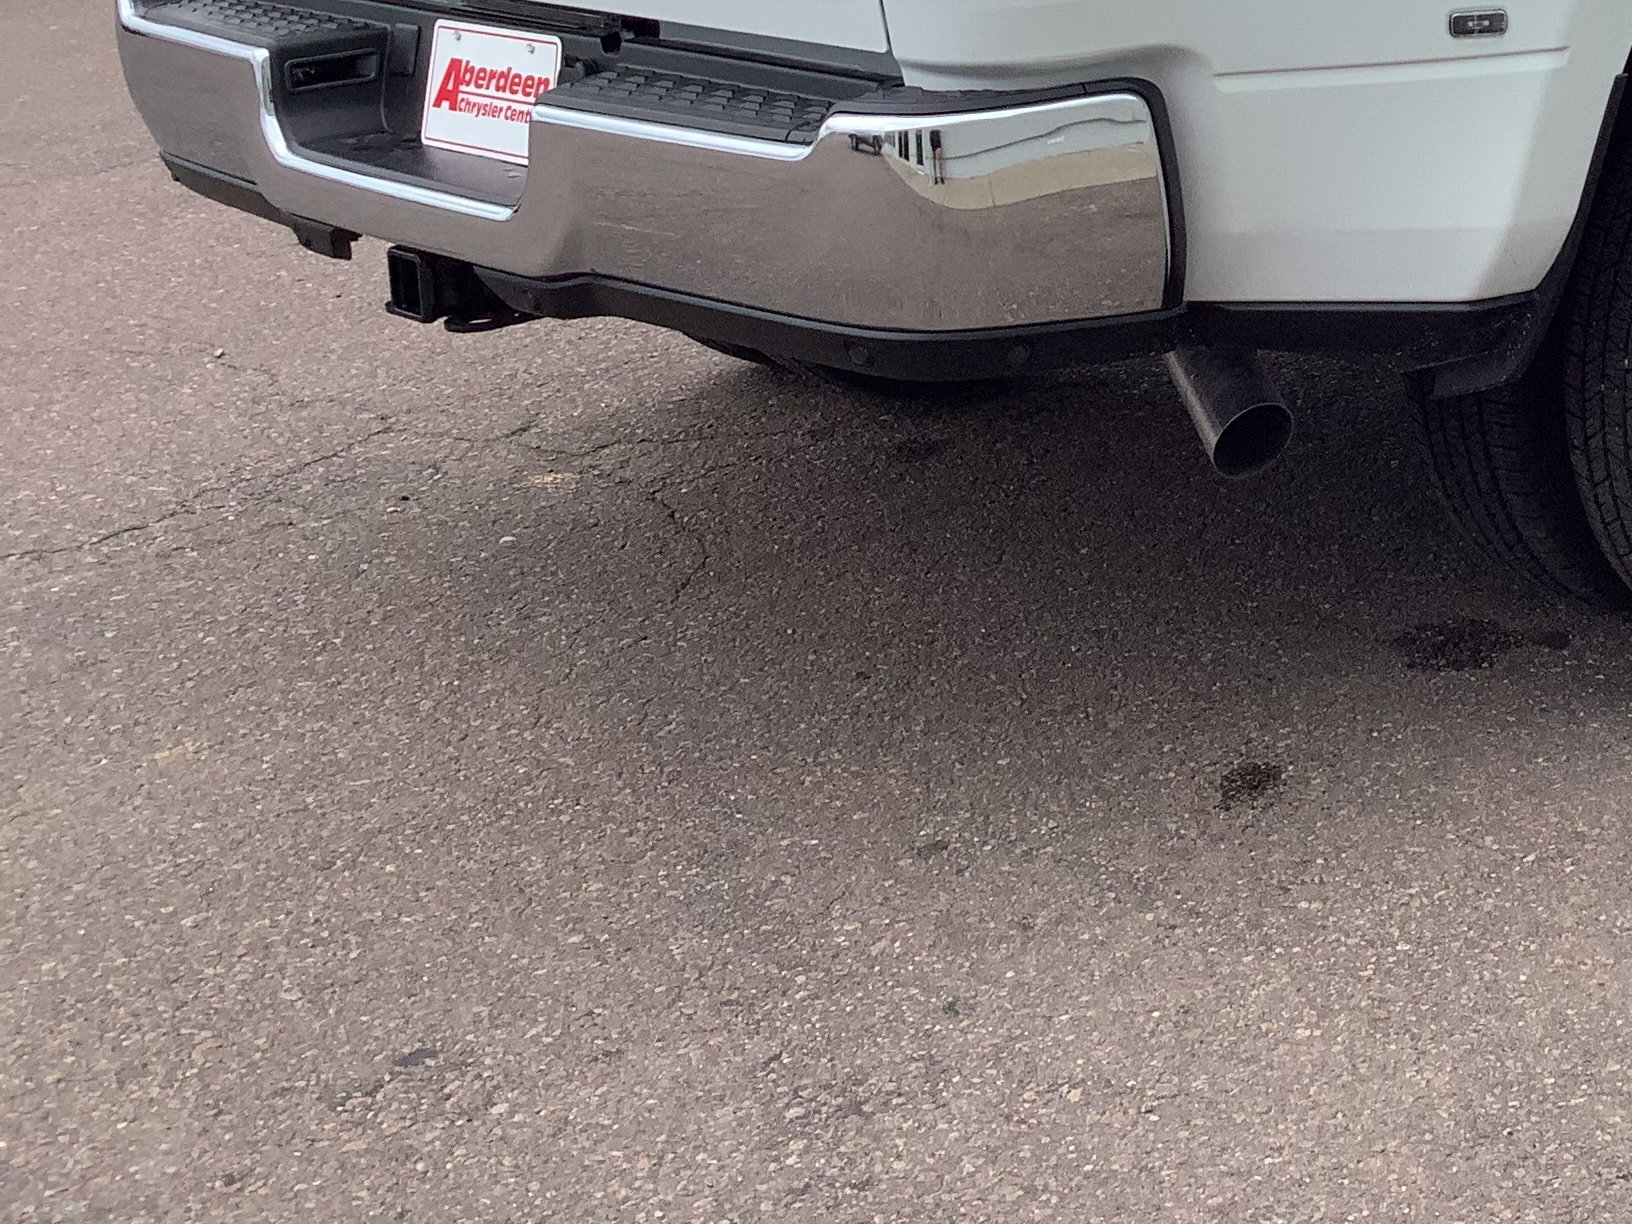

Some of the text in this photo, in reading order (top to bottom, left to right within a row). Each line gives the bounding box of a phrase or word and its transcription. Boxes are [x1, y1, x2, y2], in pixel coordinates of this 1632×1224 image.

[432, 57, 550, 111] Aberdeen
[458, 97, 532, 124] Chrysler Cent
